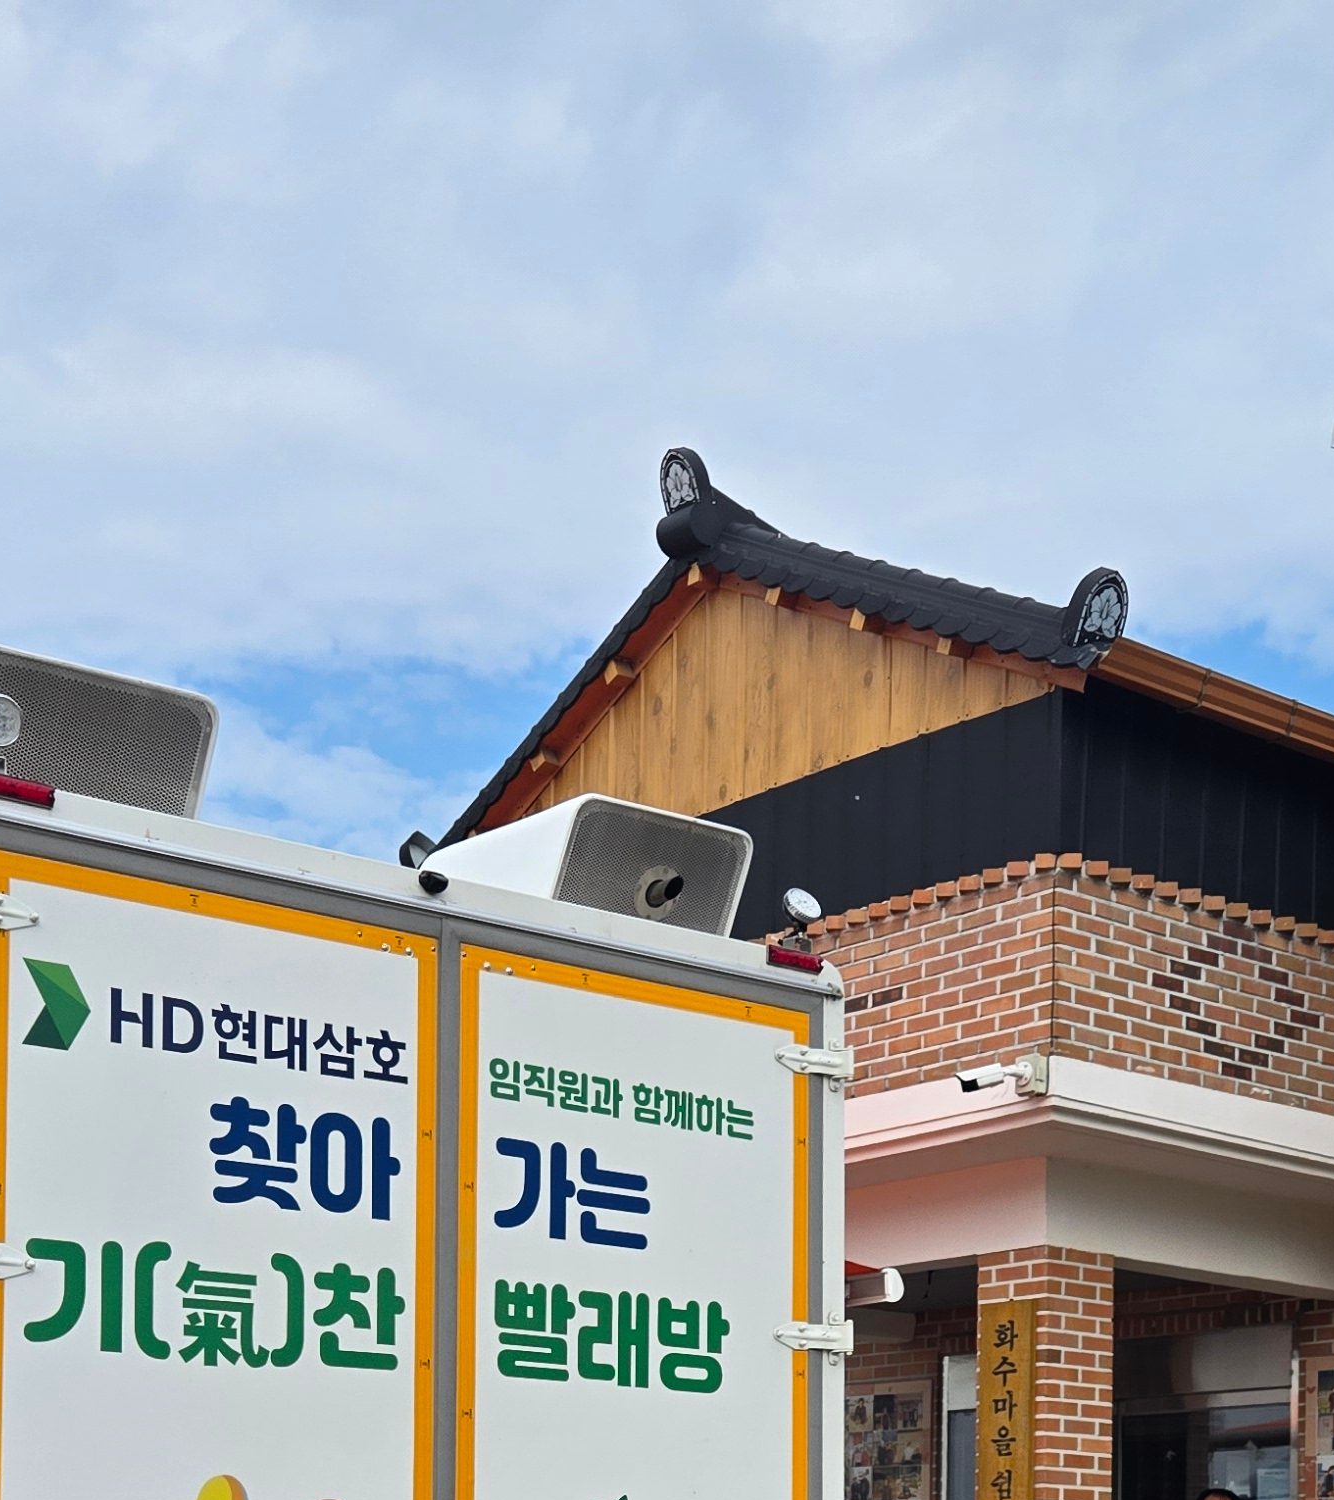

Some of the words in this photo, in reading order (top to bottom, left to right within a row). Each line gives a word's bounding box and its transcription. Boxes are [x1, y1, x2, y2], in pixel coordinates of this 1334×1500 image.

[110, 986, 409, 1085] HD현대삼호
[489, 1057, 624, 1119] 임직원과
[632, 1082, 755, 1140] 함께하는
[210, 1096, 401, 1221] 찾아
[494, 1137, 652, 1250] 가는
[24, 1237, 405, 1372] 기(氣)찬
[494, 1279, 730, 1394] 빨래방
